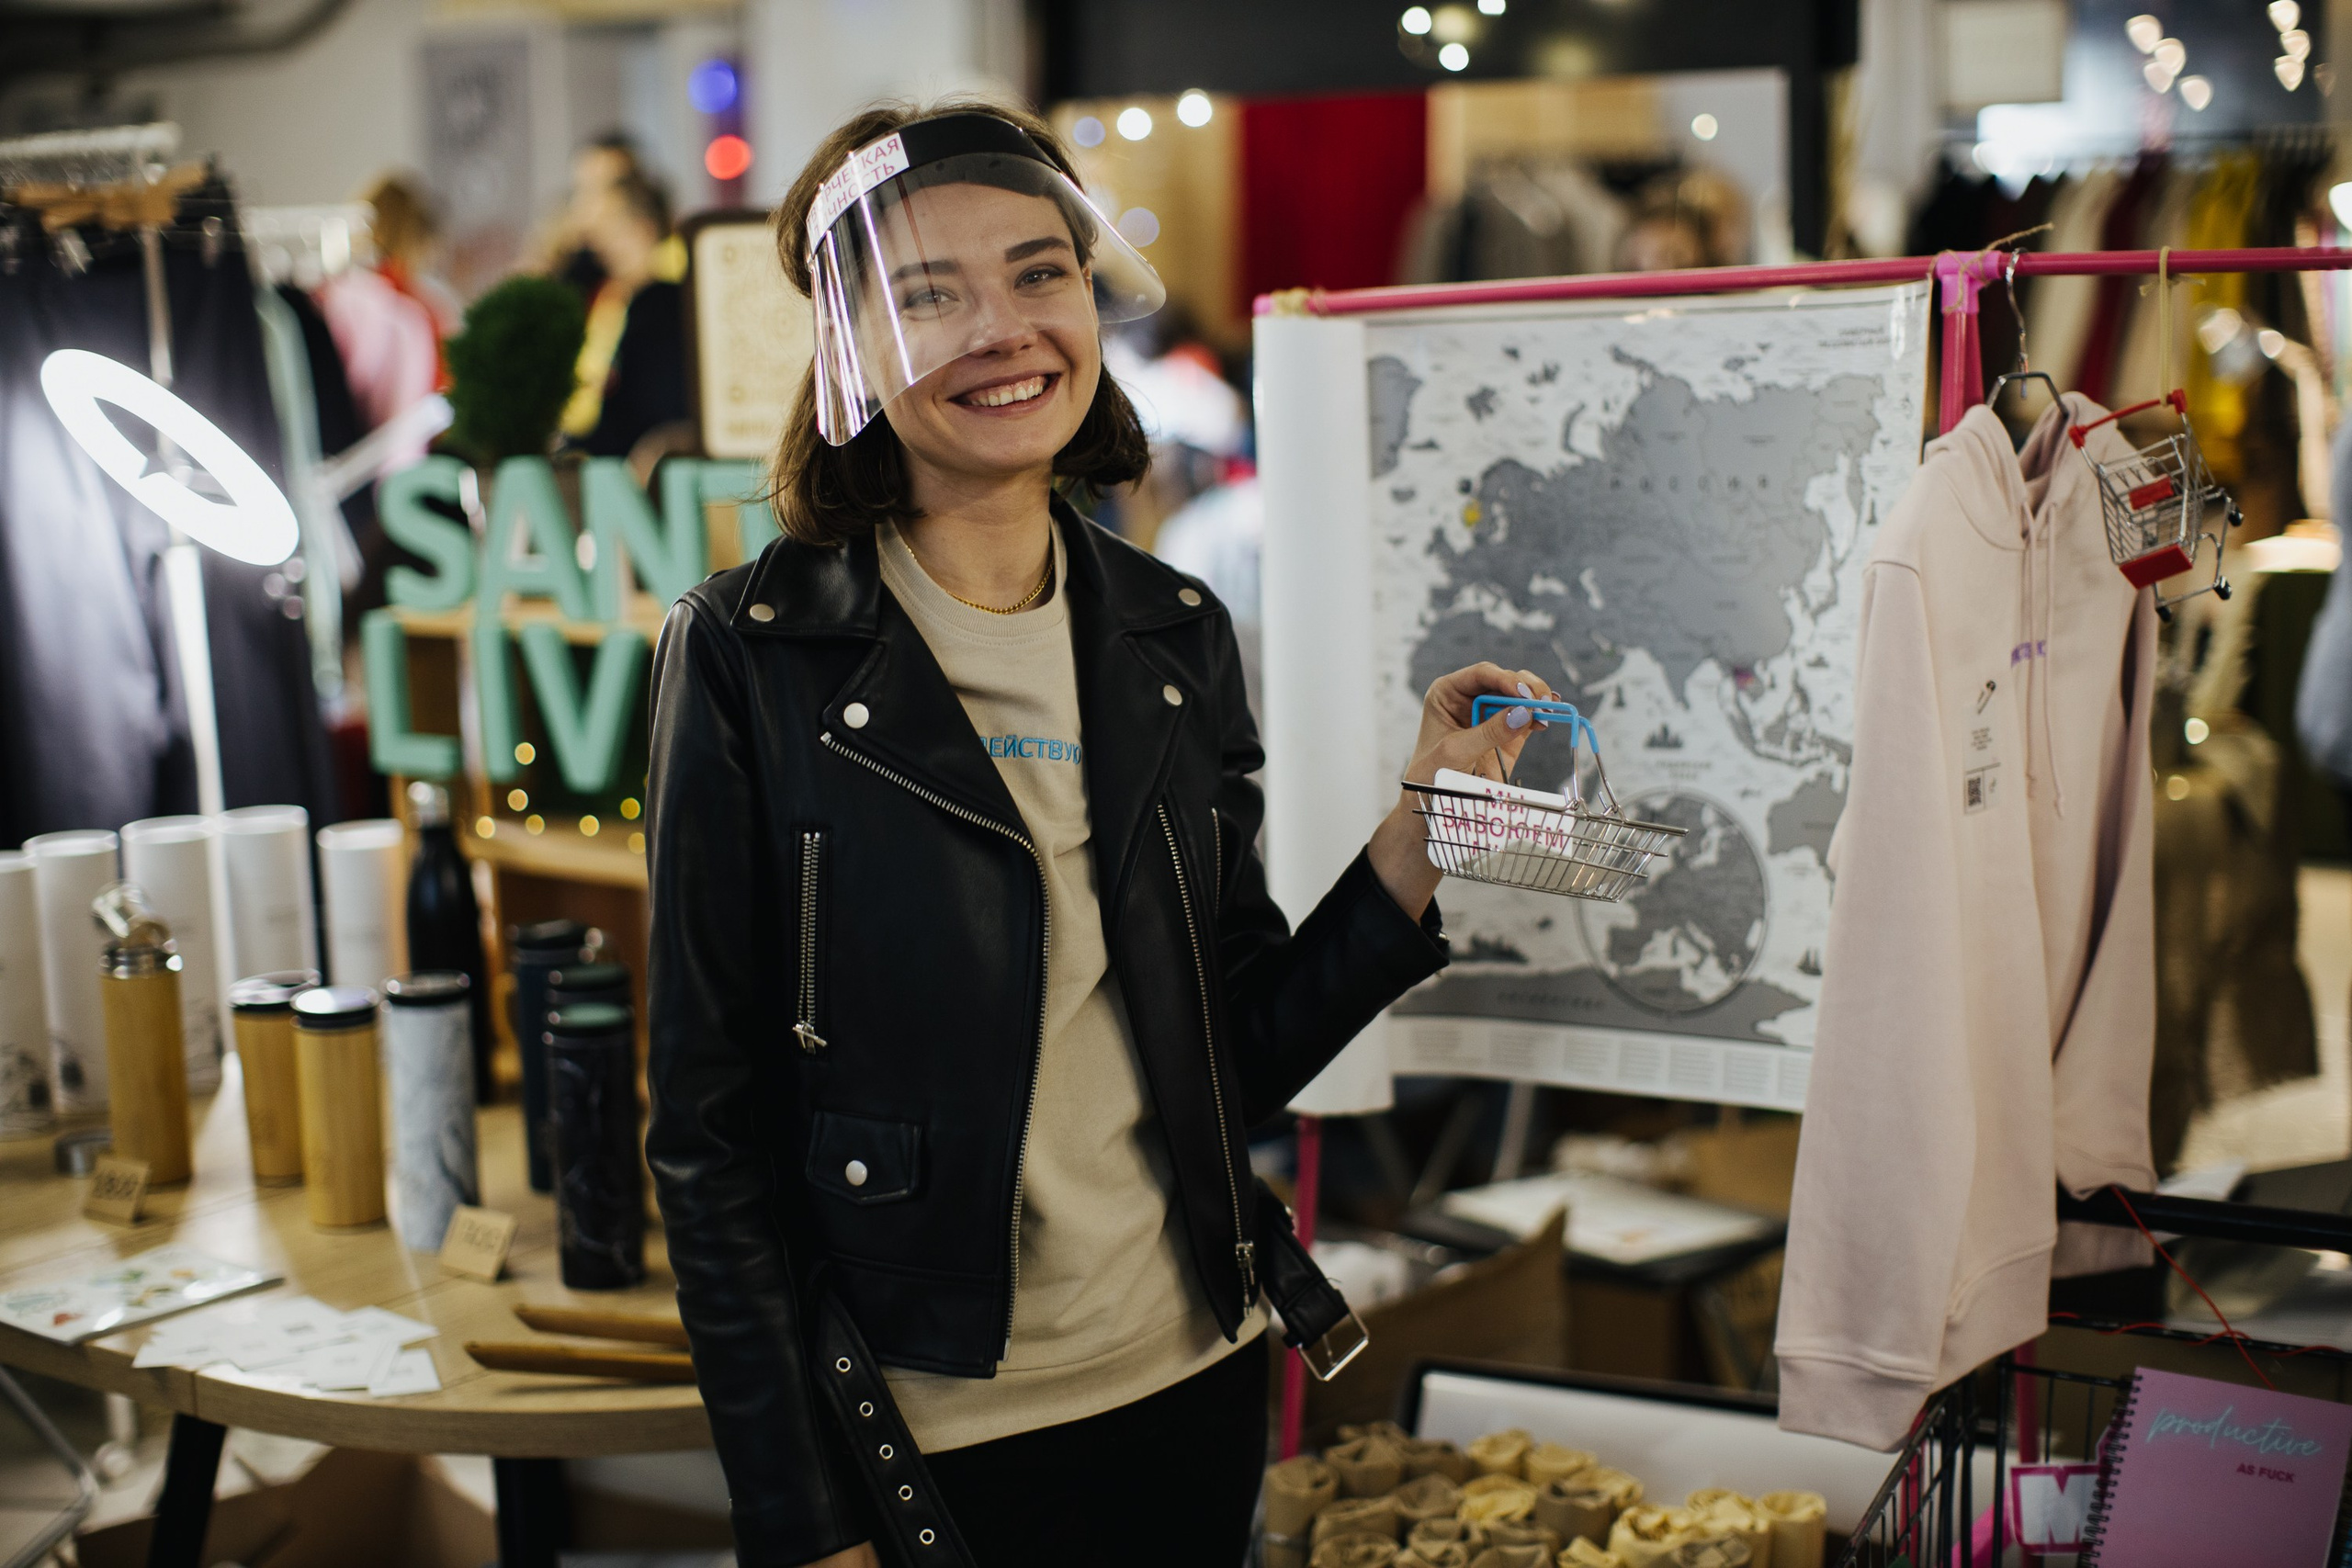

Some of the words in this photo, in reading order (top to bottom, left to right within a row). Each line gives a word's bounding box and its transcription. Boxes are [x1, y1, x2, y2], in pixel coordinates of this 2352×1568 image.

[2145, 1404, 2324, 1456] productive
[2236, 1462, 2255, 1475] AS
[2258, 1466, 2295, 1483] FUCK
